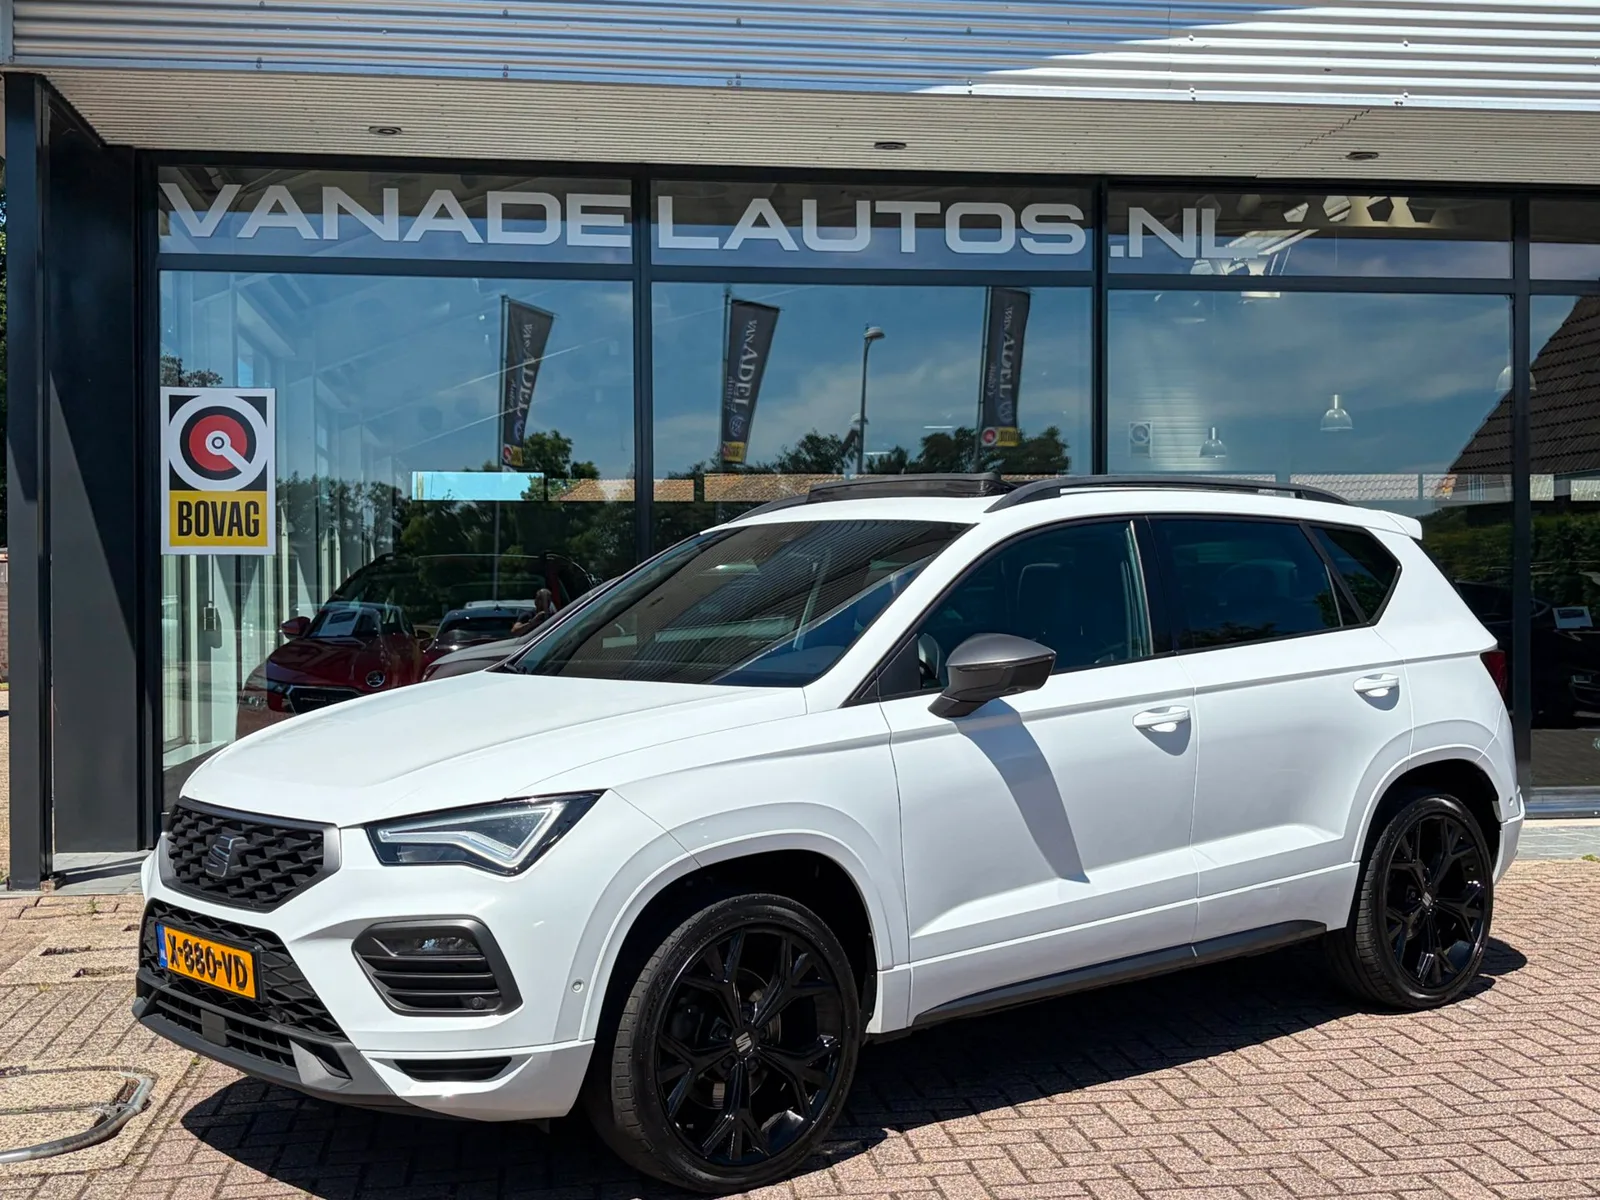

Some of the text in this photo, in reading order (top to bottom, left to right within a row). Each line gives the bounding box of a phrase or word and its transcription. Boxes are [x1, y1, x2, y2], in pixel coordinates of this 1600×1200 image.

[731, 344, 759, 413] ADEL
[177, 500, 260, 537] BOVAG
[167, 933, 248, 991] X-880-VD
